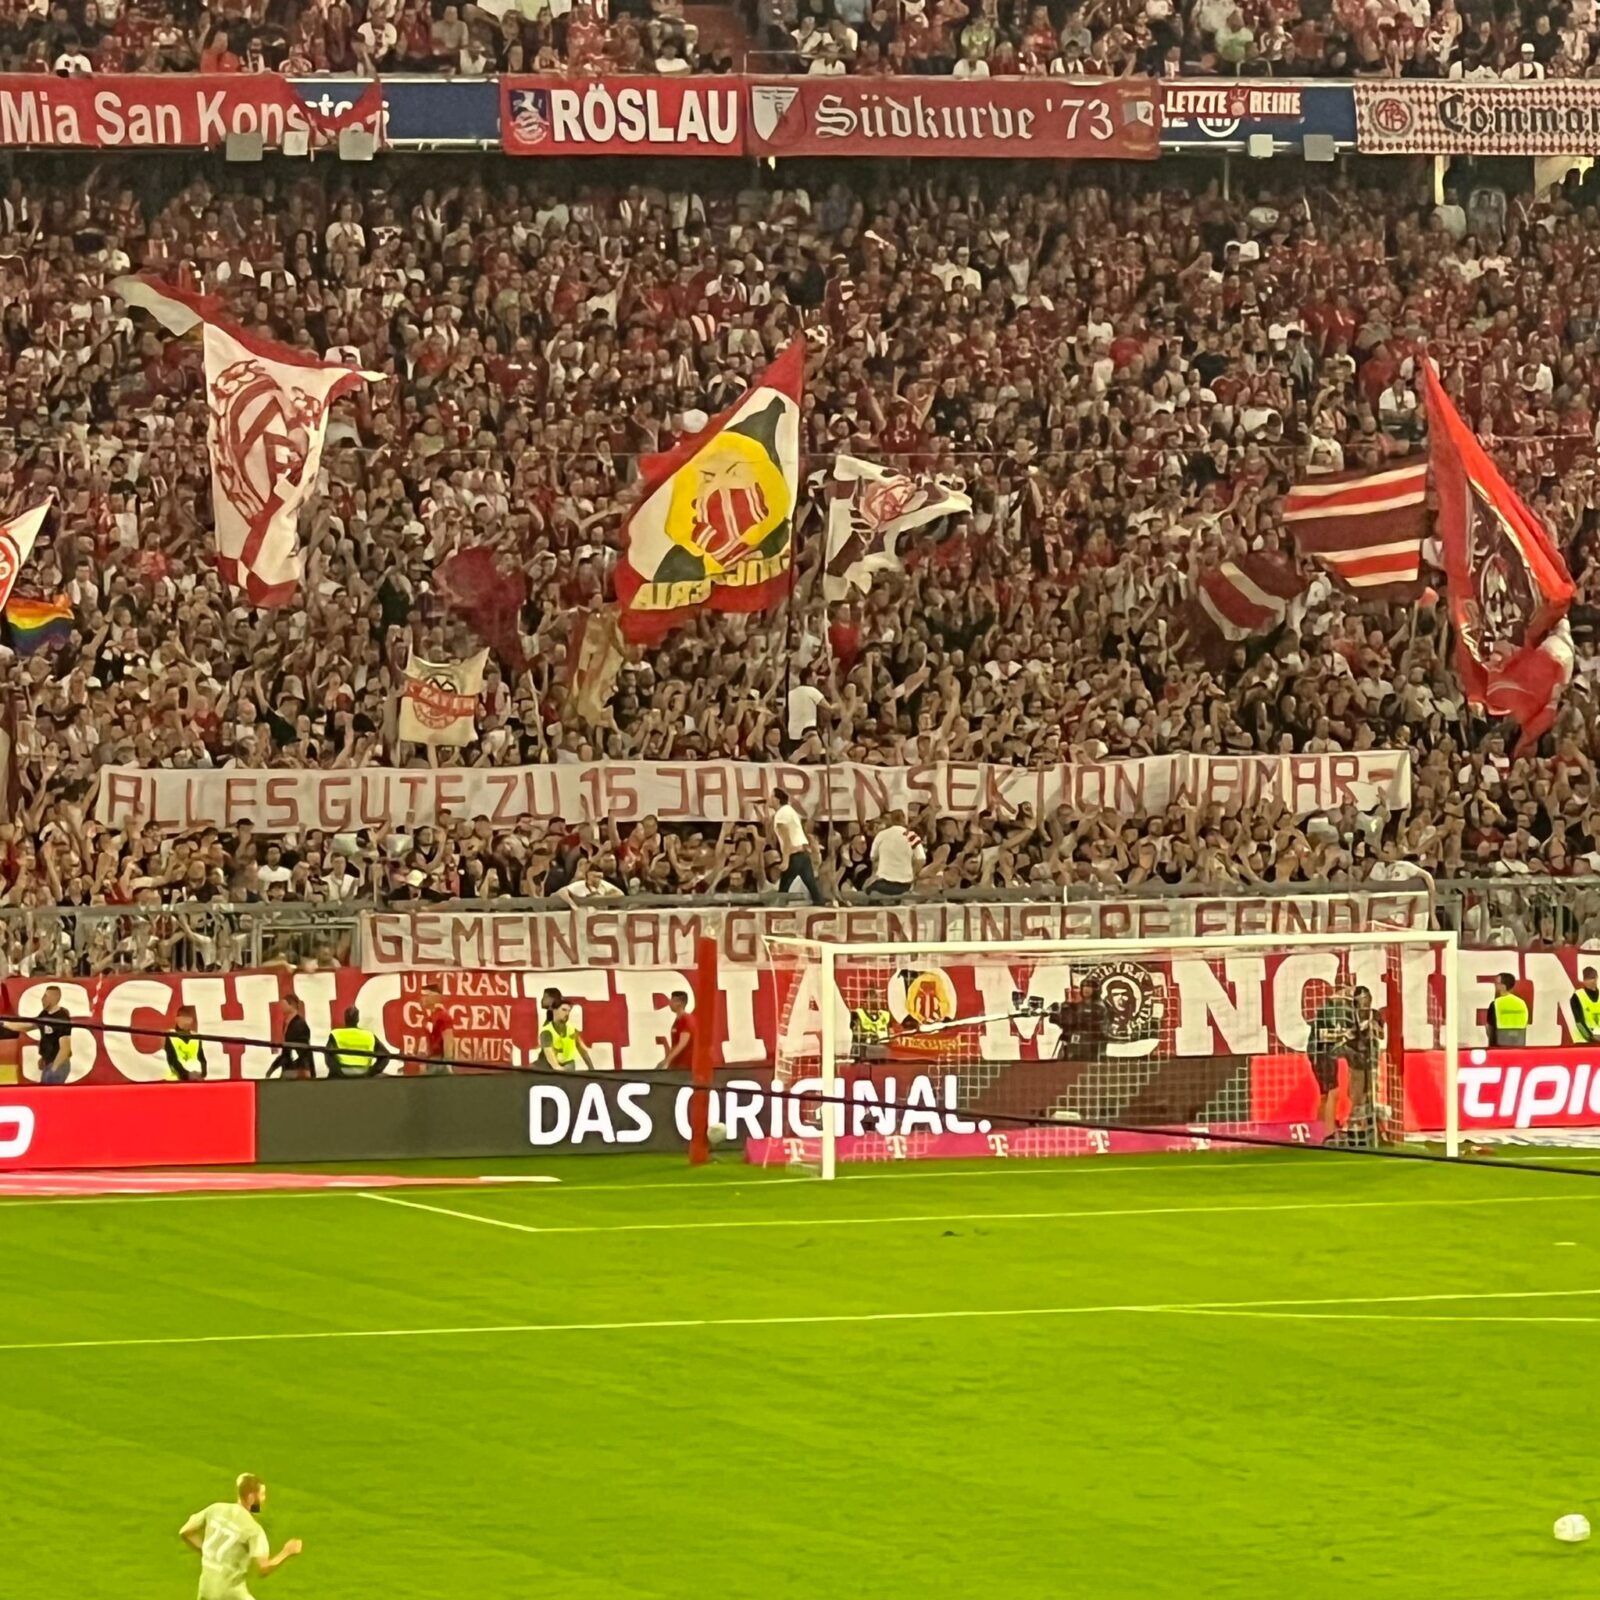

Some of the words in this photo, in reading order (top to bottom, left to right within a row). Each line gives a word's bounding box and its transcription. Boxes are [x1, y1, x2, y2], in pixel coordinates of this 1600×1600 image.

[0, 91, 81, 144] Mia
[94, 91, 181, 145] San
[550, 83, 738, 145] RÖSLAU
[815, 94, 1035, 140] Südkurve
[1166, 91, 1228, 114] LETZTE
[1250, 91, 1301, 115] REIHE
[108, 773, 299, 828] ALLES
[318, 774, 466, 830] GUTE
[486, 770, 560, 826] ZU
[580, 766, 639, 818] 15
[656, 765, 891, 828] JAHREN
[370, 913, 700, 968] GEMEINSAM
[402, 1001, 513, 1031] GGEN
[529, 1082, 653, 1146] DAS
[1457, 1049, 1600, 1128] tipi
